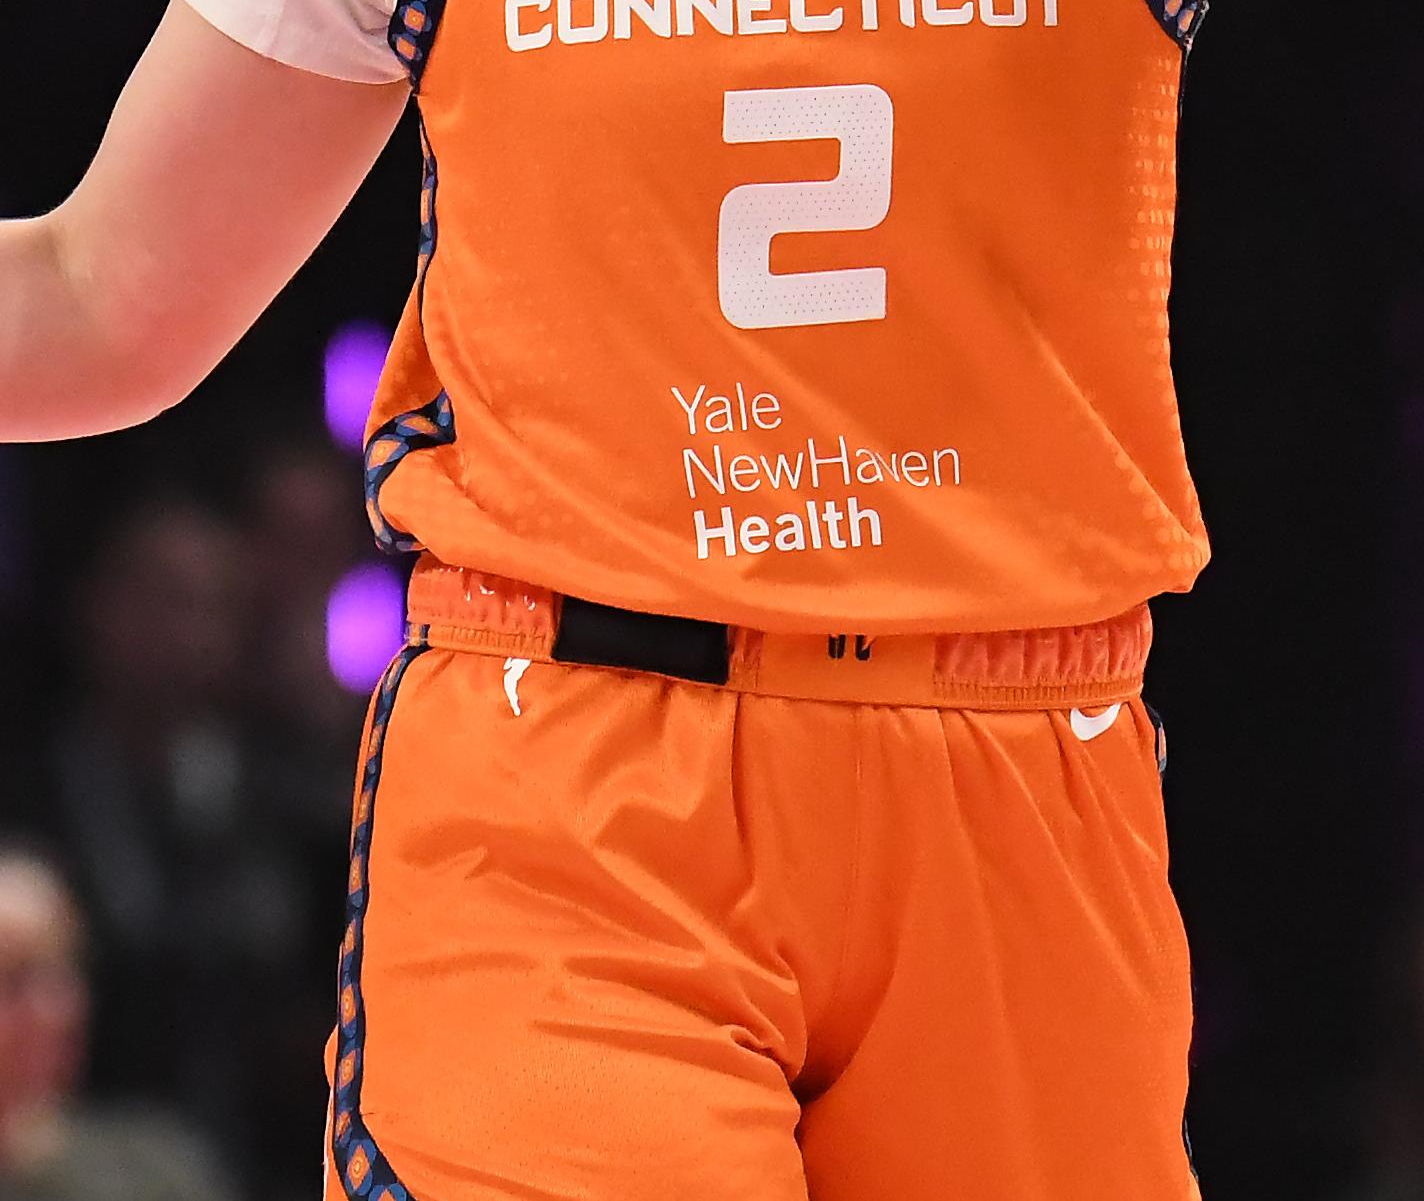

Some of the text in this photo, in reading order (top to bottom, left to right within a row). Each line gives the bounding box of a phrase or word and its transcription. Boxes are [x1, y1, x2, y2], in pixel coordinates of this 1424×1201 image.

[717, 83, 893, 329] 2
[670, 382, 782, 435] Yale
[682, 435, 960, 499] NewHaven
[693, 496, 882, 559] Health
